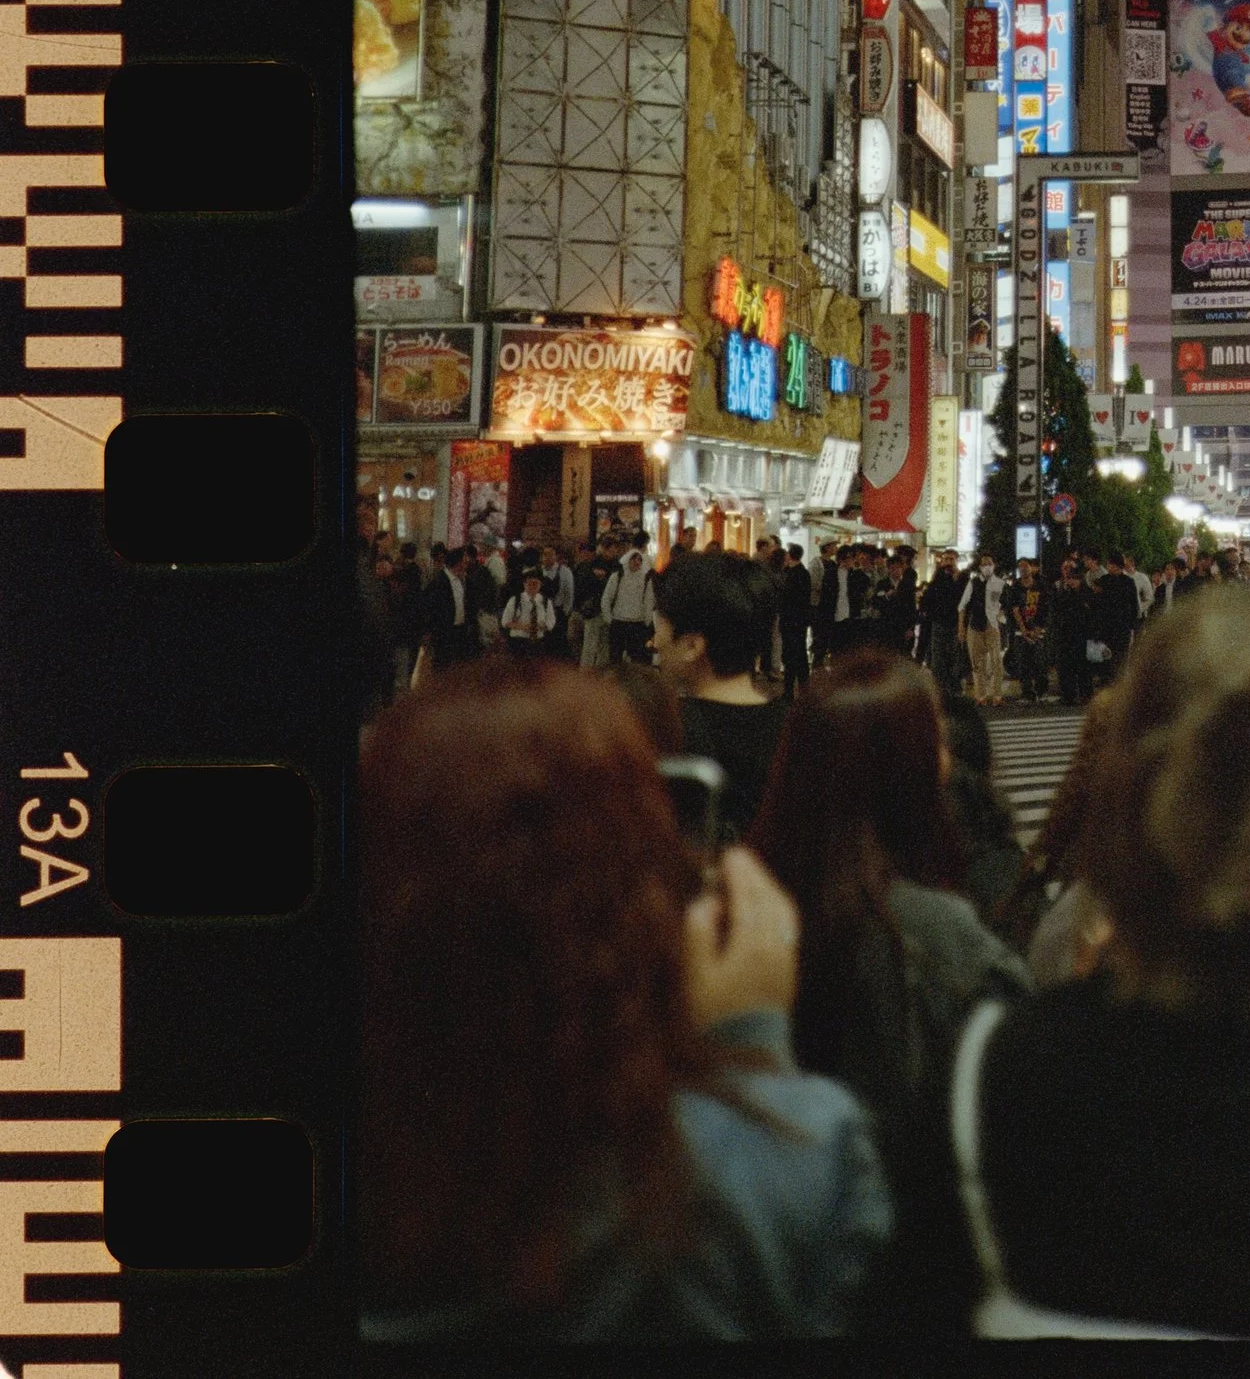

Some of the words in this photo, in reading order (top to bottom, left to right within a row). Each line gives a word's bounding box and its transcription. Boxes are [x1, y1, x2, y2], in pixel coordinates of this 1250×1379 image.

[1019, 208, 1038, 368] GODZILLA
[383, 332, 452, 352] らーめん
[499, 342, 695, 377] OKONOMIYAKI
[870, 323, 892, 421] トラノコ
[506, 374, 681, 416] お好み焼き
[1018, 389, 1036, 467] ROAD
[20, 752, 90, 907] 13A
